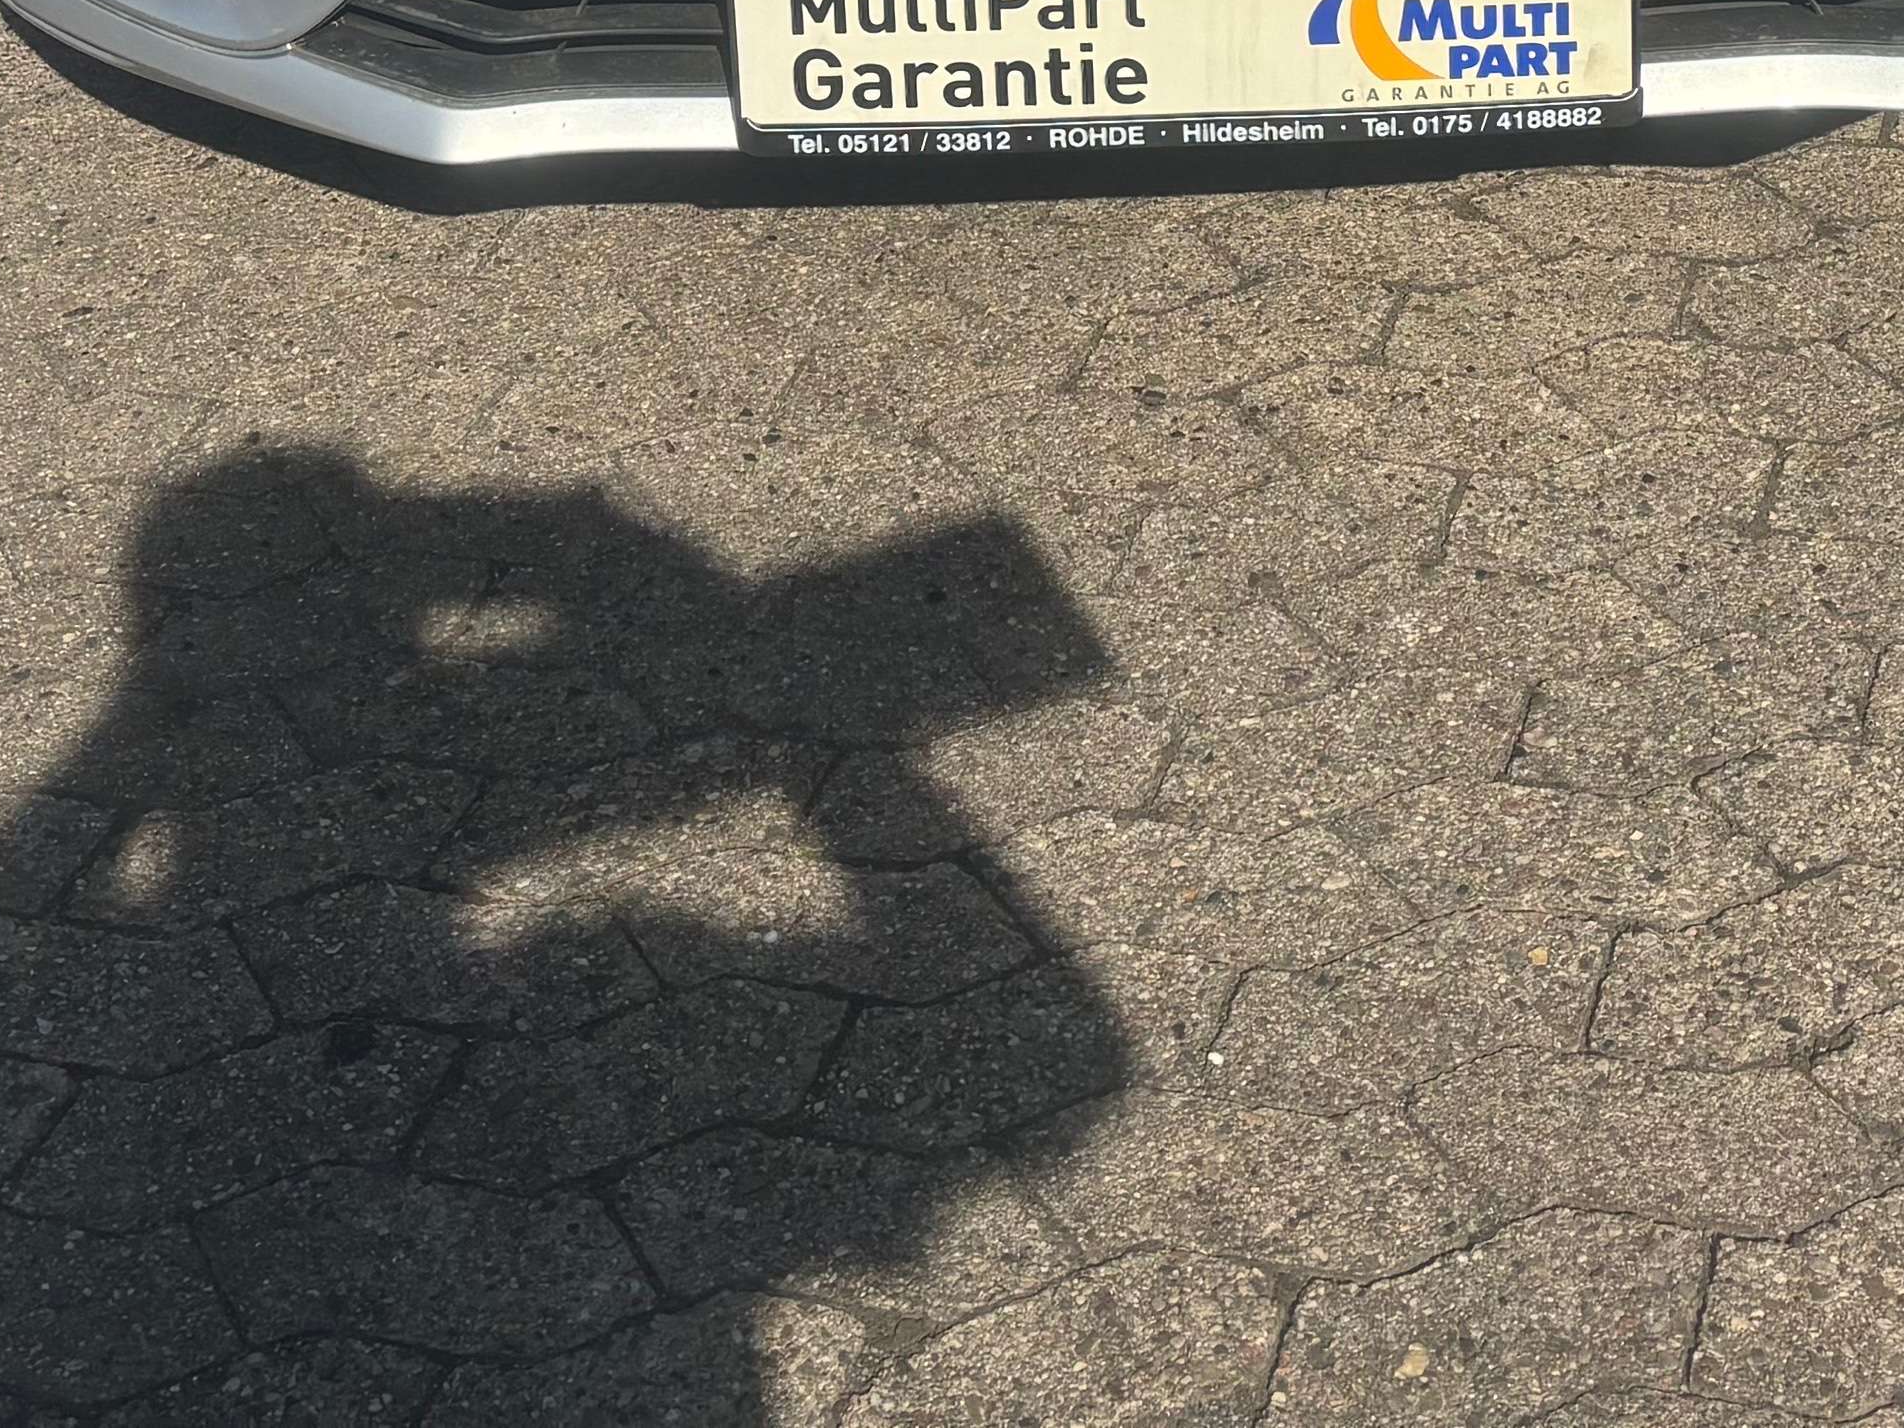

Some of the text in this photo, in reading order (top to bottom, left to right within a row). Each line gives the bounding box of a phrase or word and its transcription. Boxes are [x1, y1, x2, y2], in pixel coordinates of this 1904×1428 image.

[793, 42, 1149, 111] Garantie
[1448, 41, 1578, 80] PART
[1341, 80, 1571, 103] GARANTIE AG
[788, 133, 831, 155] Tel.
[838, 133, 911, 154] 05121
[935, 131, 1012, 152] 33812
[1048, 125, 1146, 150] ROHDE
[1182, 120, 1325, 144] Hildesheim
[1361, 117, 1405, 138] Tel.
[1412, 114, 1473, 136] 0175
[1495, 107, 1603, 131] 4188882
